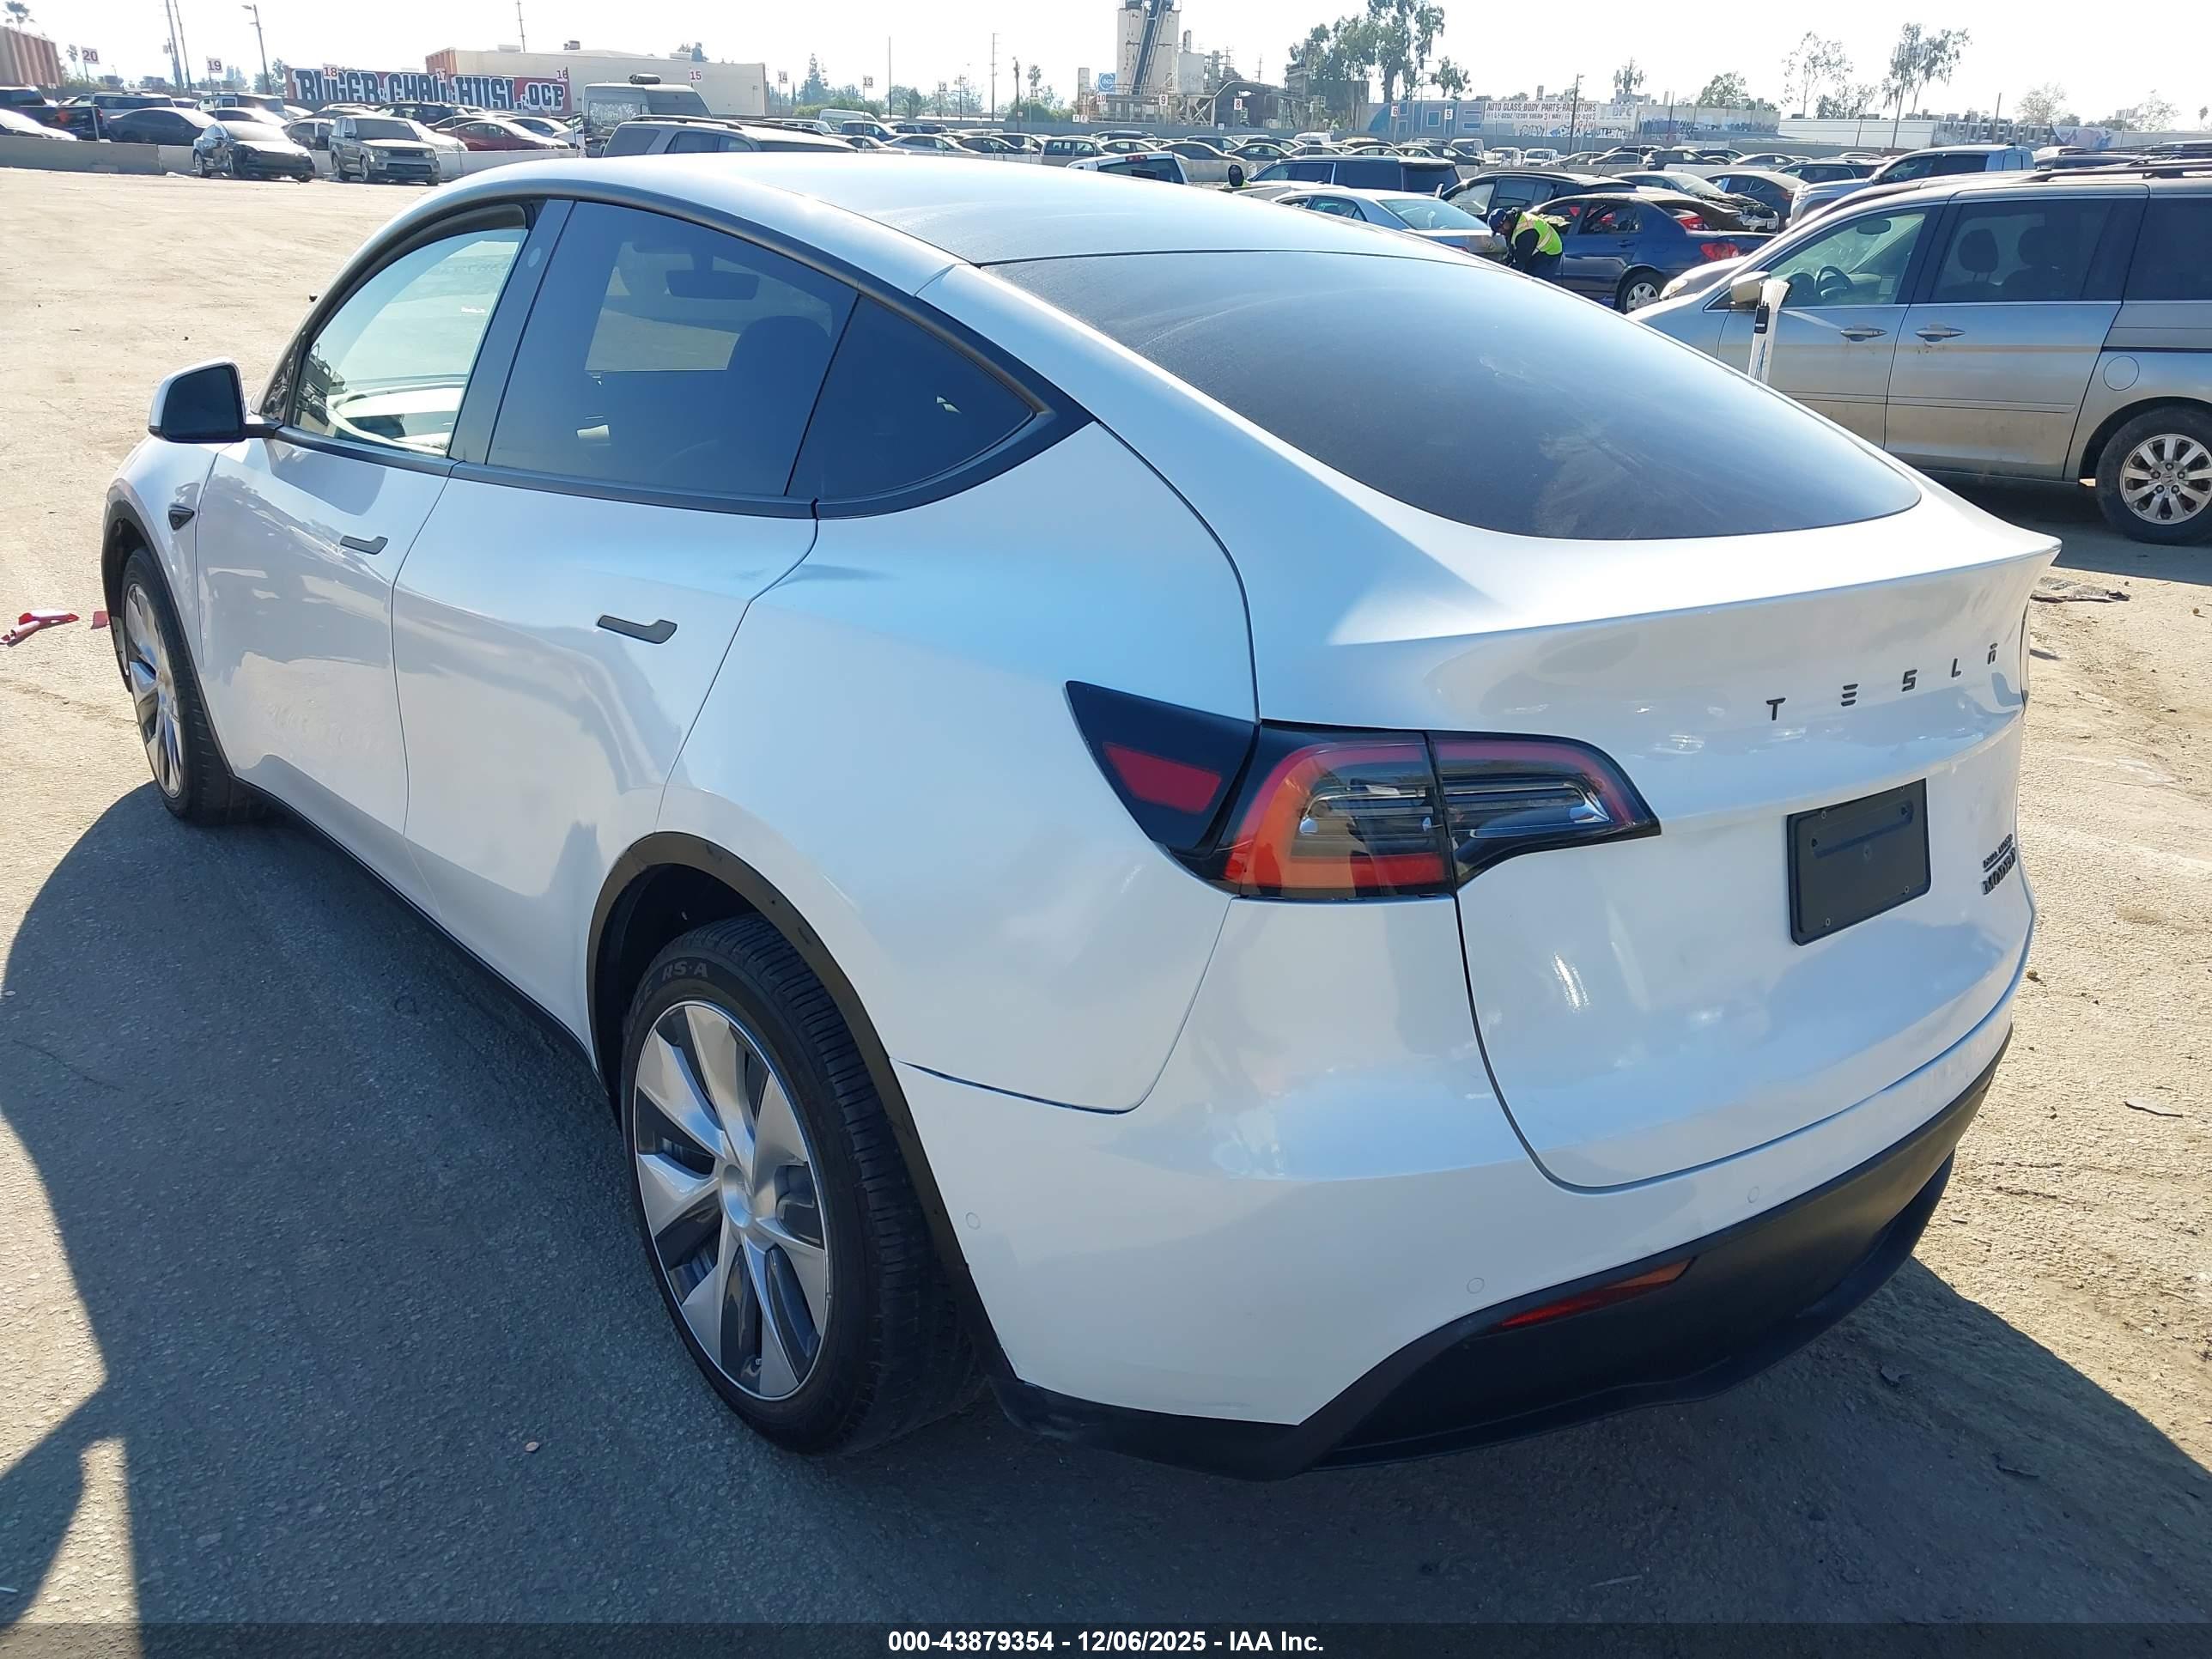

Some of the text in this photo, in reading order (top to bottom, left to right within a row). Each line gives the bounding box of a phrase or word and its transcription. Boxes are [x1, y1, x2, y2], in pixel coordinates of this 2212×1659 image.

[82, 50, 99, 62] 20
[208, 60, 222, 71] 19
[324, 67, 338, 77] 18
[557, 70, 569, 80] 16
[690, 70, 702, 81] 15
[778, 73, 788, 82] 14
[864, 77, 873, 87] 13
[939, 83, 948, 92] 12
[1161, 96, 1166, 105] 9
[1236, 100, 1241, 109] 8
[1393, 107, 1398, 116] 6
[1486, 103, 1501, 112] AUTO
[1766, 642, 1998, 721] TESLA
